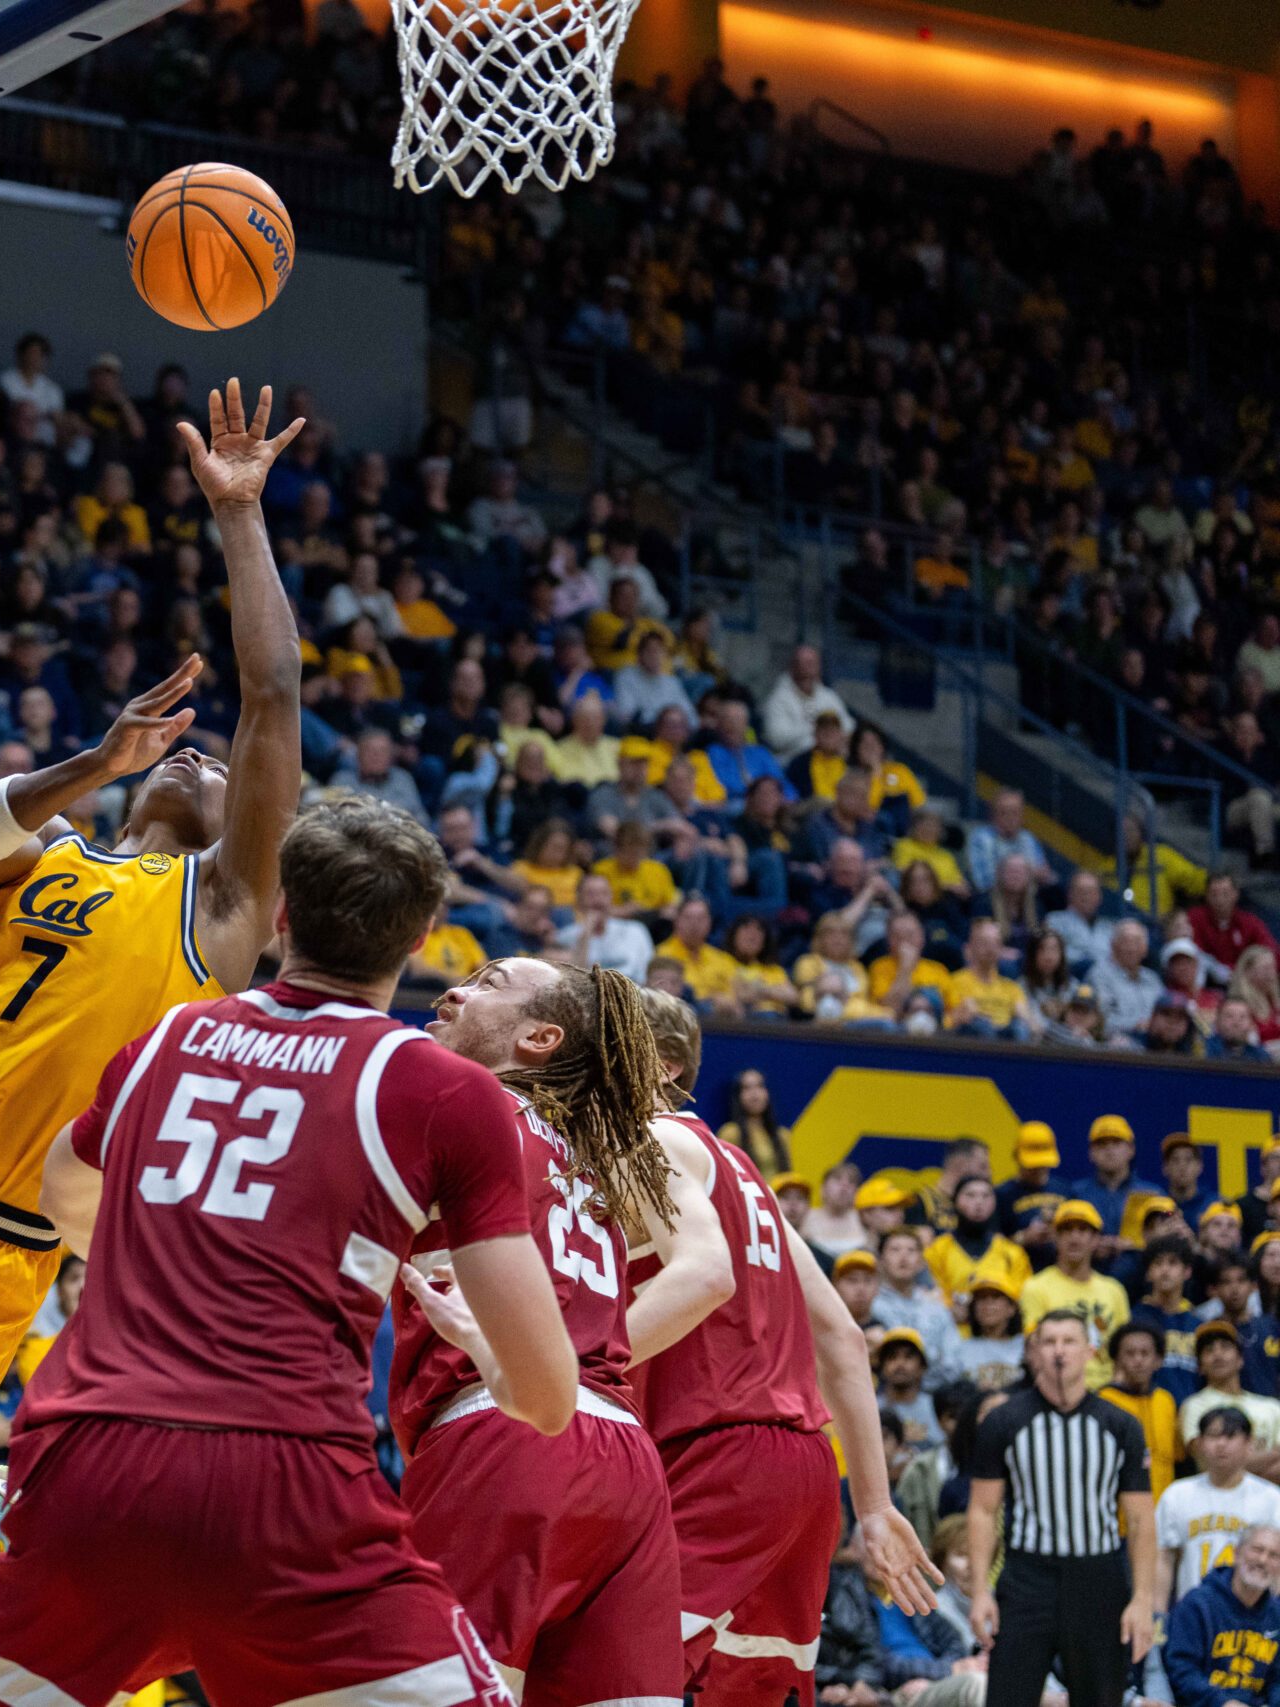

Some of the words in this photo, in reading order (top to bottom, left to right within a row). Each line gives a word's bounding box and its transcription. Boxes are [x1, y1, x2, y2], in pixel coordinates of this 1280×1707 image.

[10, 873, 114, 937] Cal
[0, 936, 68, 1022] 7
[179, 1016, 347, 1075] CAMMANN
[137, 1072, 306, 1221] 52
[548, 1158, 619, 1299] 25
[737, 1173, 781, 1273] 15
